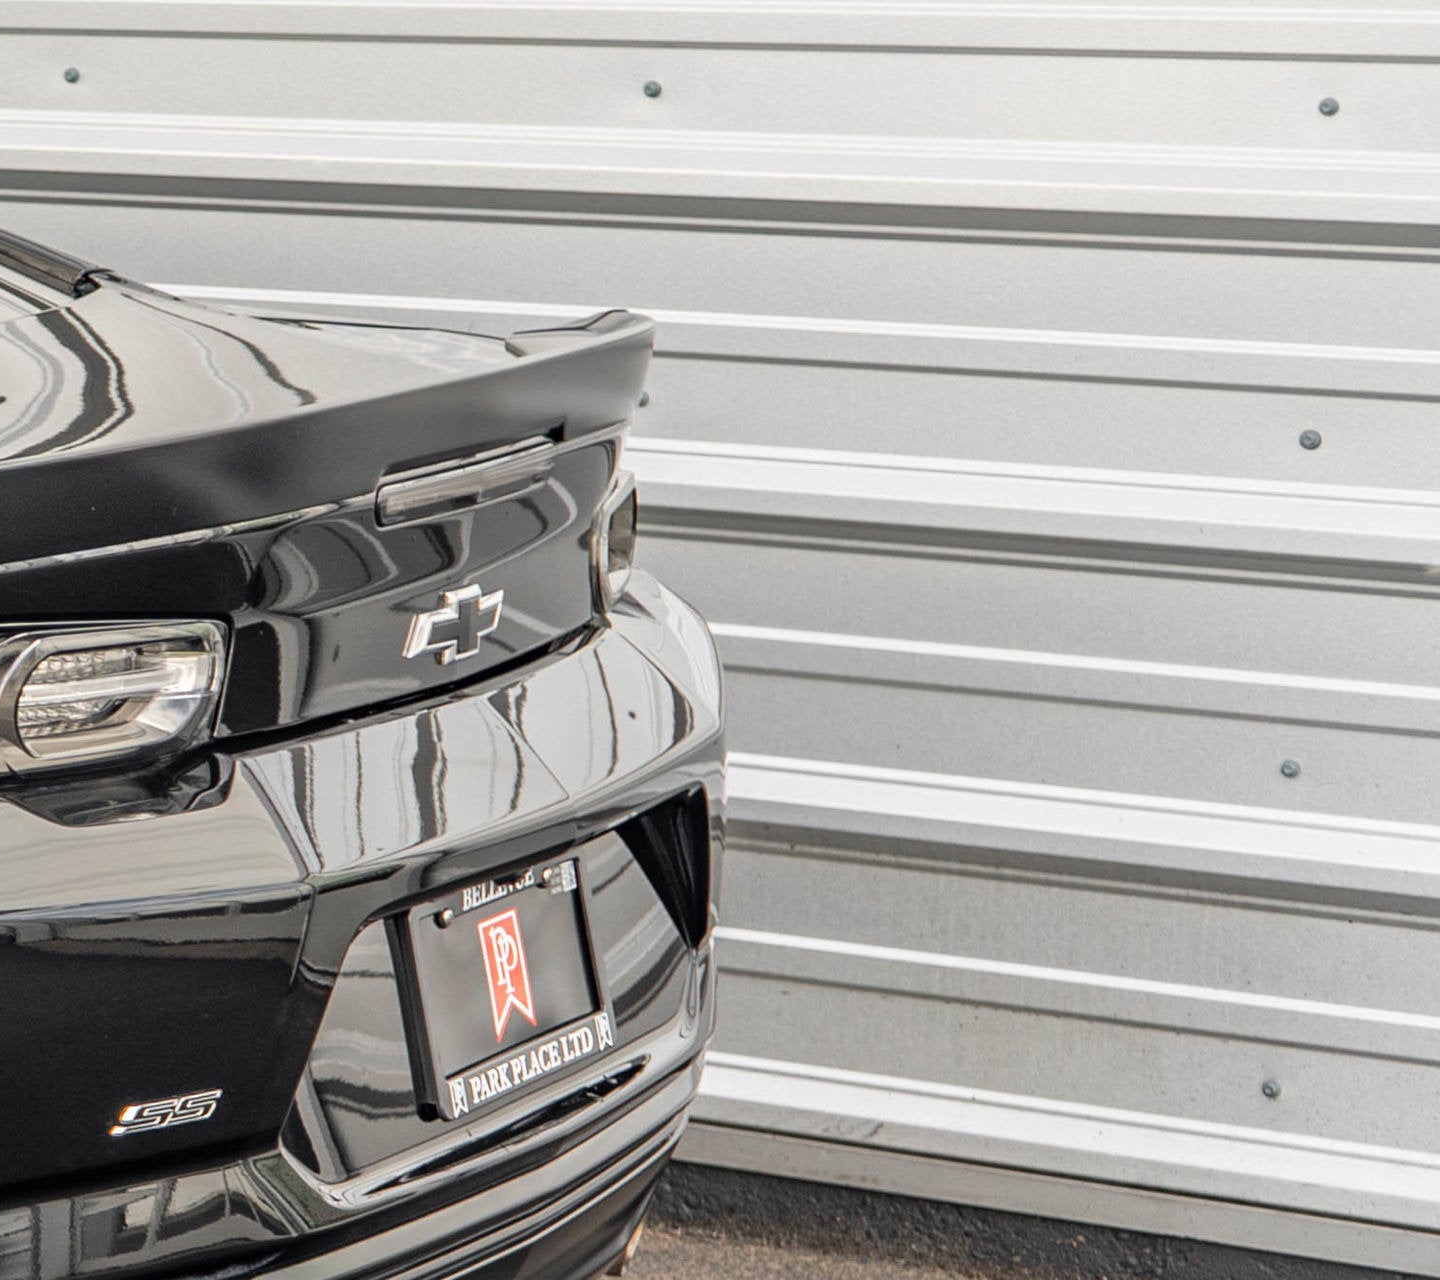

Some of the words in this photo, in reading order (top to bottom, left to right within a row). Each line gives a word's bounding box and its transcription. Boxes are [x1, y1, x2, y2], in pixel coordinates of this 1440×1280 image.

[469, 1063, 512, 1104] PARK
[509, 1040, 562, 1086] PLACE
[560, 1026, 594, 1062] LTD
